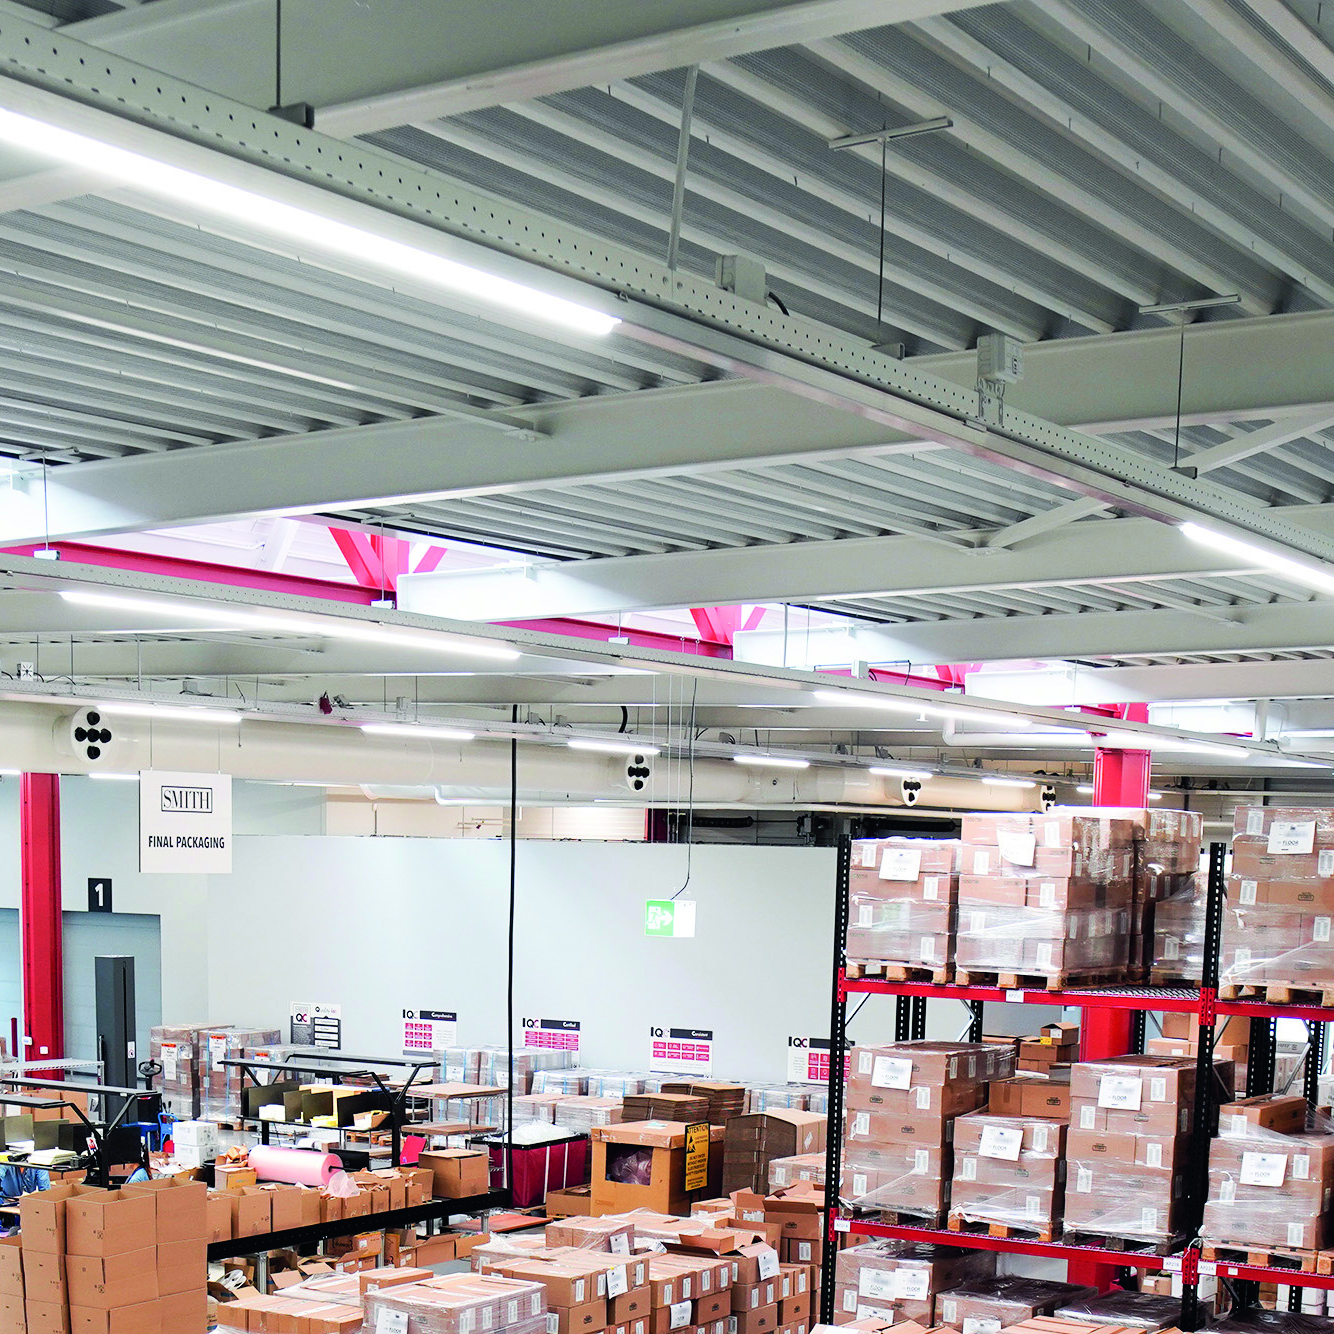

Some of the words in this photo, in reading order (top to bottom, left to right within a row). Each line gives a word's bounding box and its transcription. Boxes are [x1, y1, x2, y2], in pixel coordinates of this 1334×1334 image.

[162, 788, 210, 811] SMITH
[148, 836, 174, 849] FINAL
[176, 836, 225, 850] PACKAGING
[94, 884, 104, 907] 1
